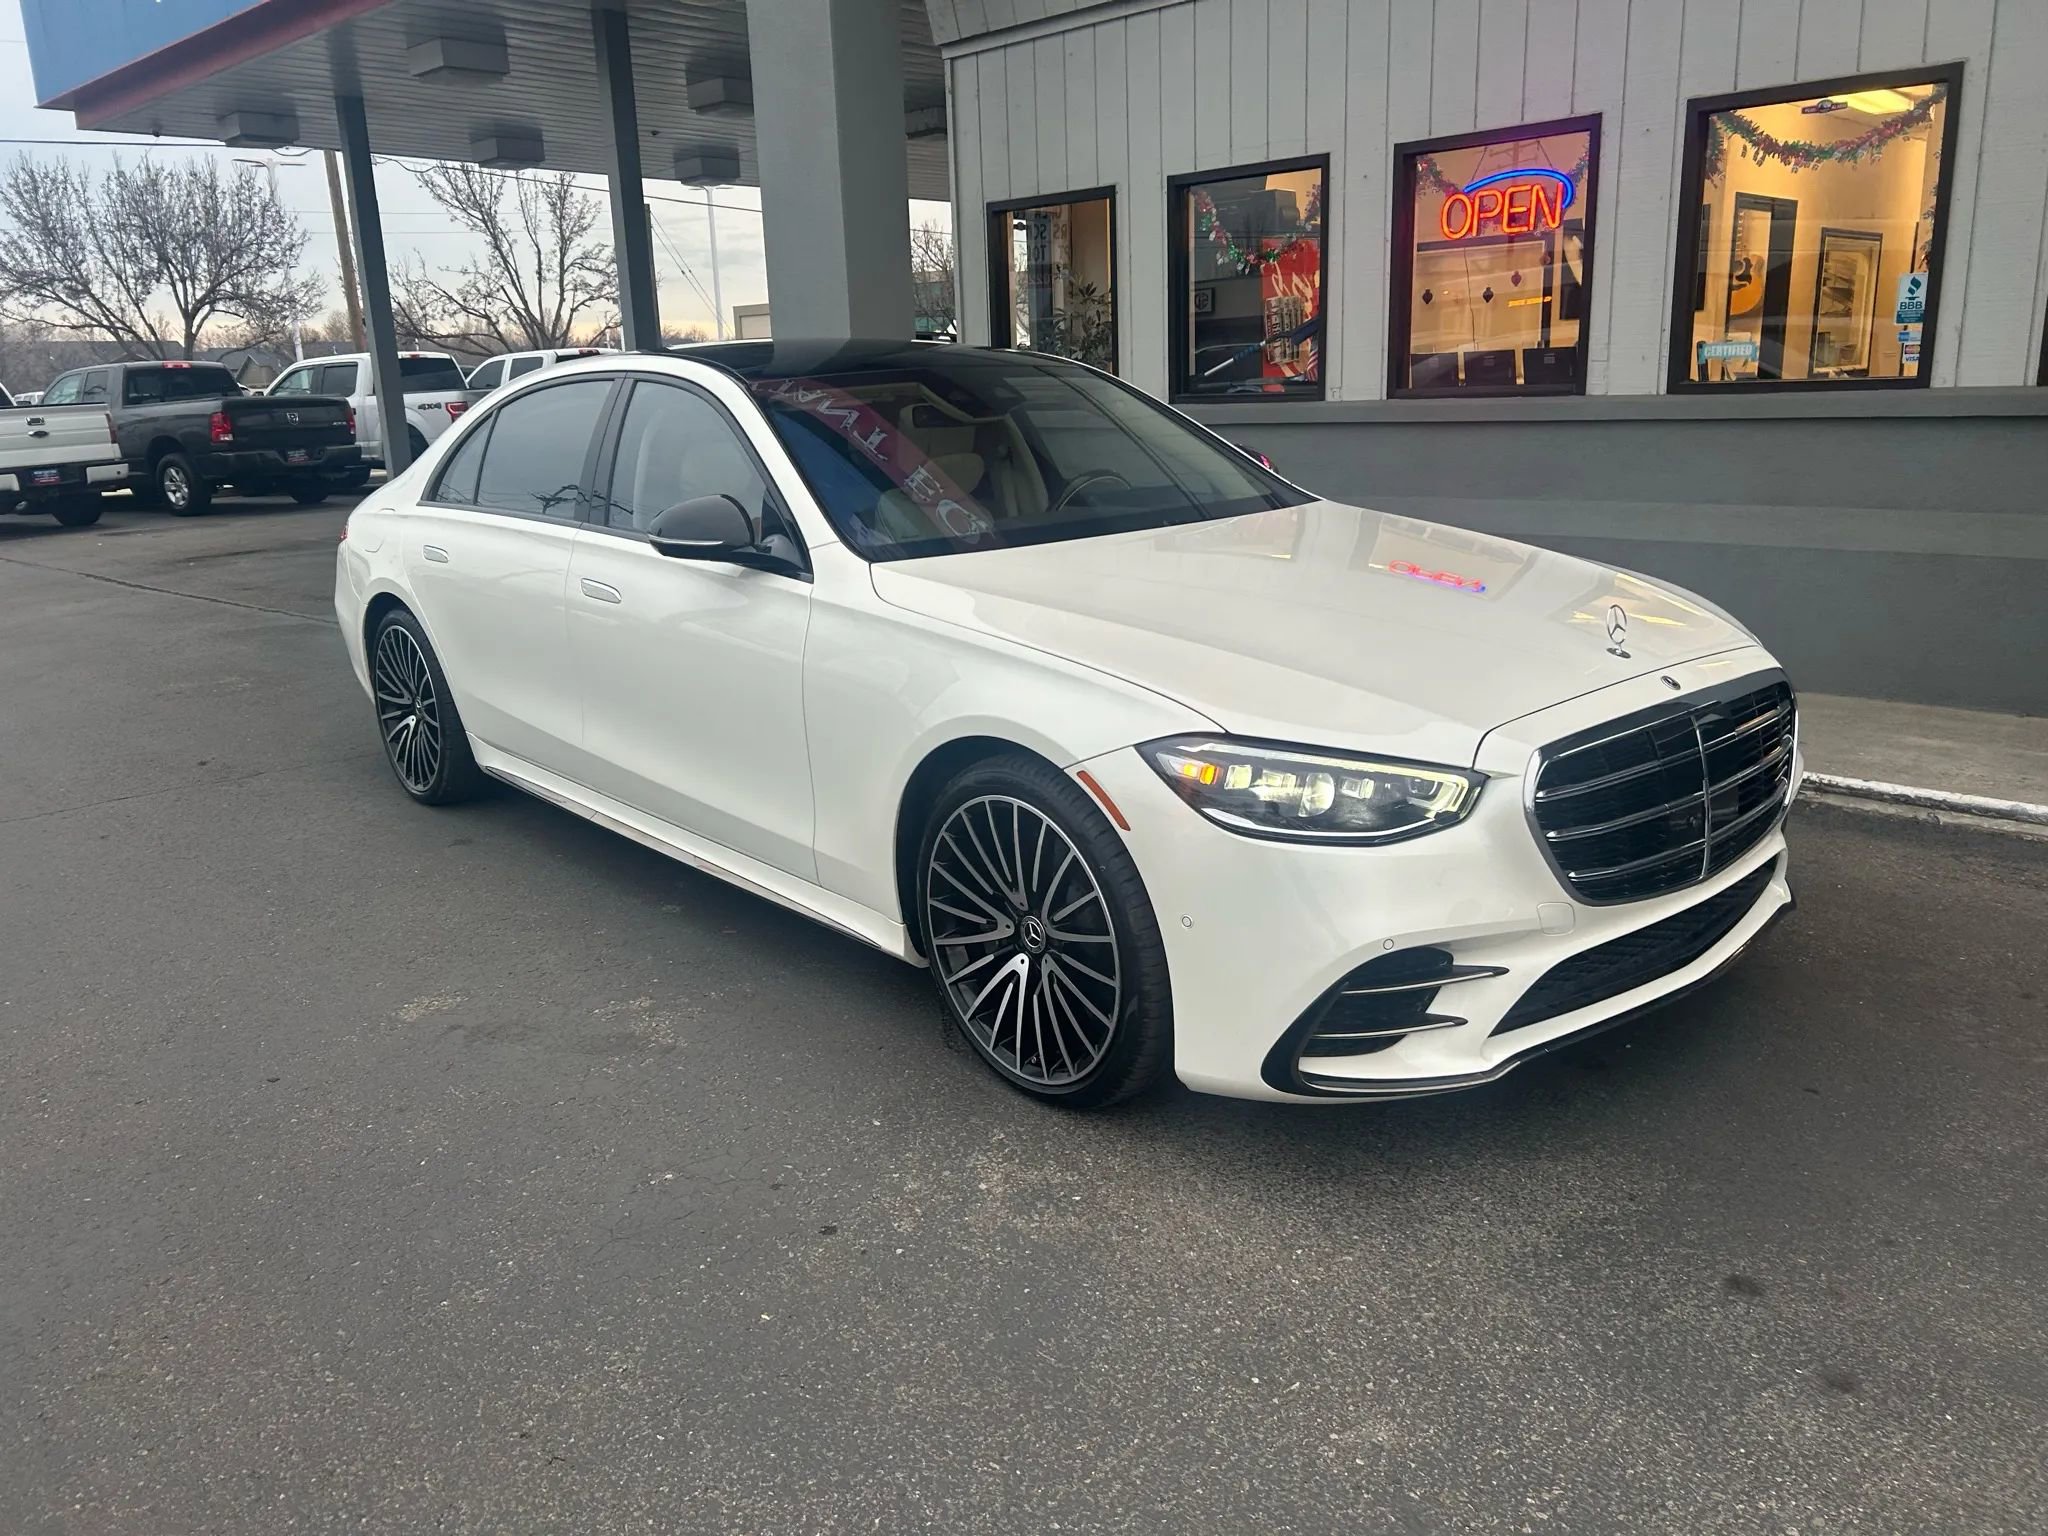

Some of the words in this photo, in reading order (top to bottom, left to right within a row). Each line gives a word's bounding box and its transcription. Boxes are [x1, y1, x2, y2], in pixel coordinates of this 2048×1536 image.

[1441, 182, 1564, 240] OPEN
[1900, 302, 1923, 310] BBB
[1704, 344, 1753, 358] CERTIFIED
